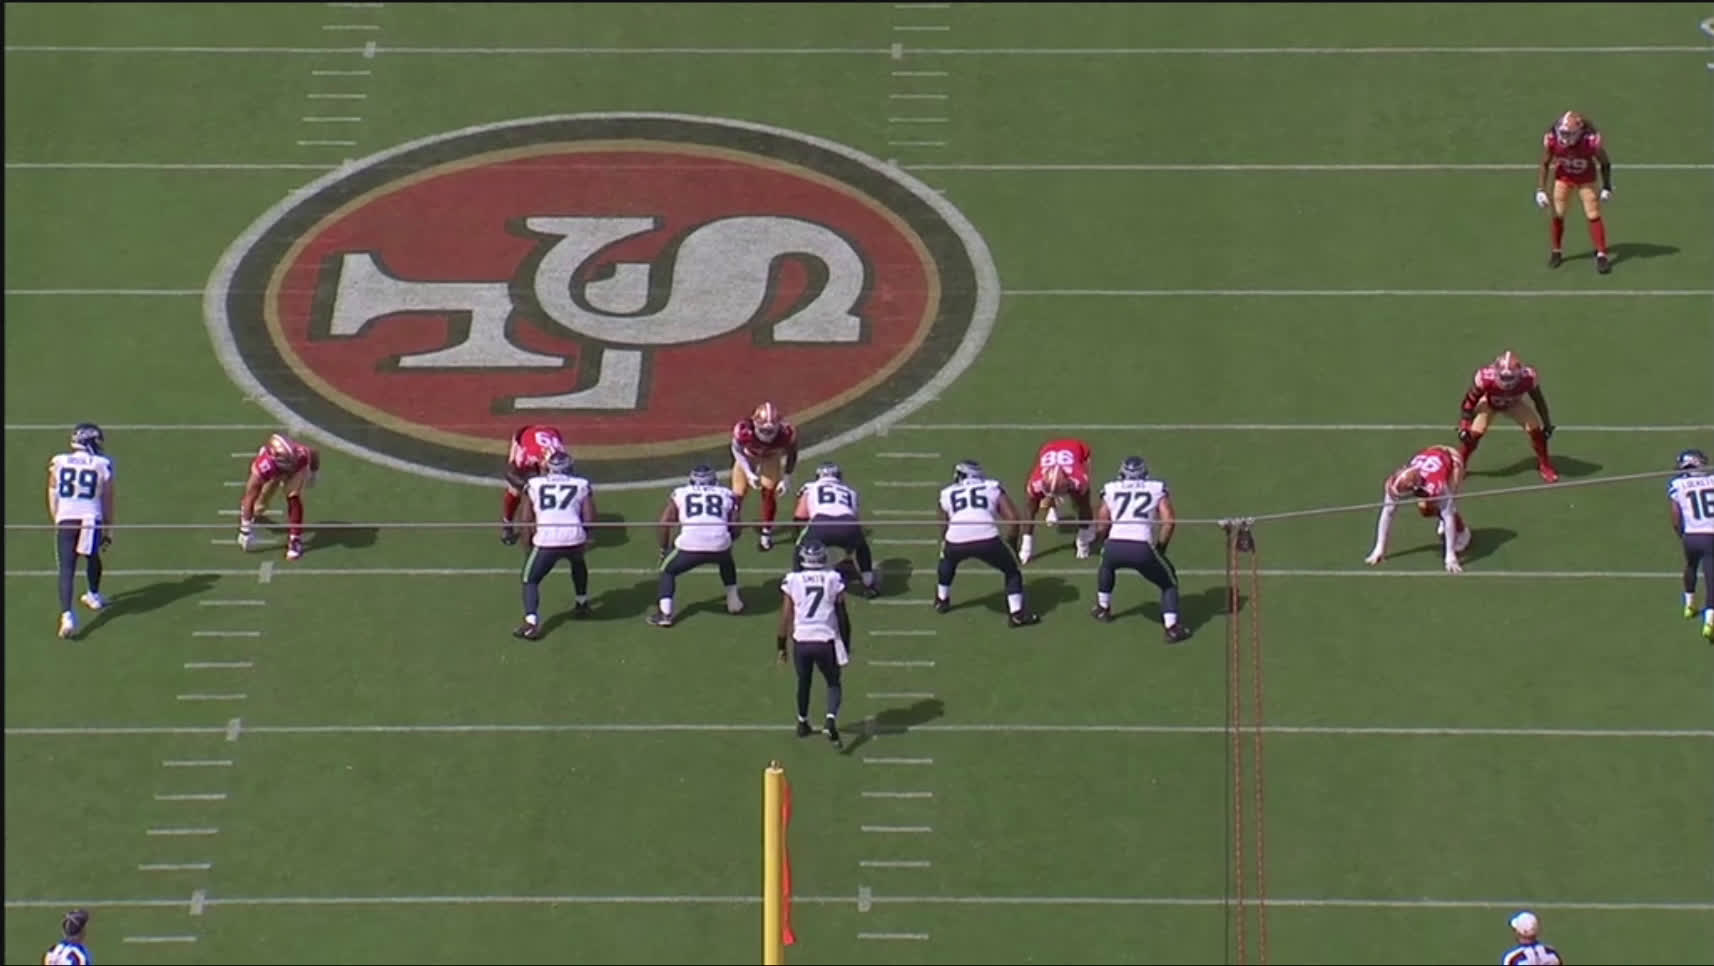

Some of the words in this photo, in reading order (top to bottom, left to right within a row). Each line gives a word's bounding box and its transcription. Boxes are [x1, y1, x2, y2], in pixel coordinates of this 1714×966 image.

[60, 468, 97, 499] 89
[539, 484, 578, 510] 67
[818, 485, 853, 508] 63
[685, 493, 723, 518] 68
[950, 485, 988, 513] 66
[1114, 492, 1152, 520] 72
[805, 586, 824, 618] 7
